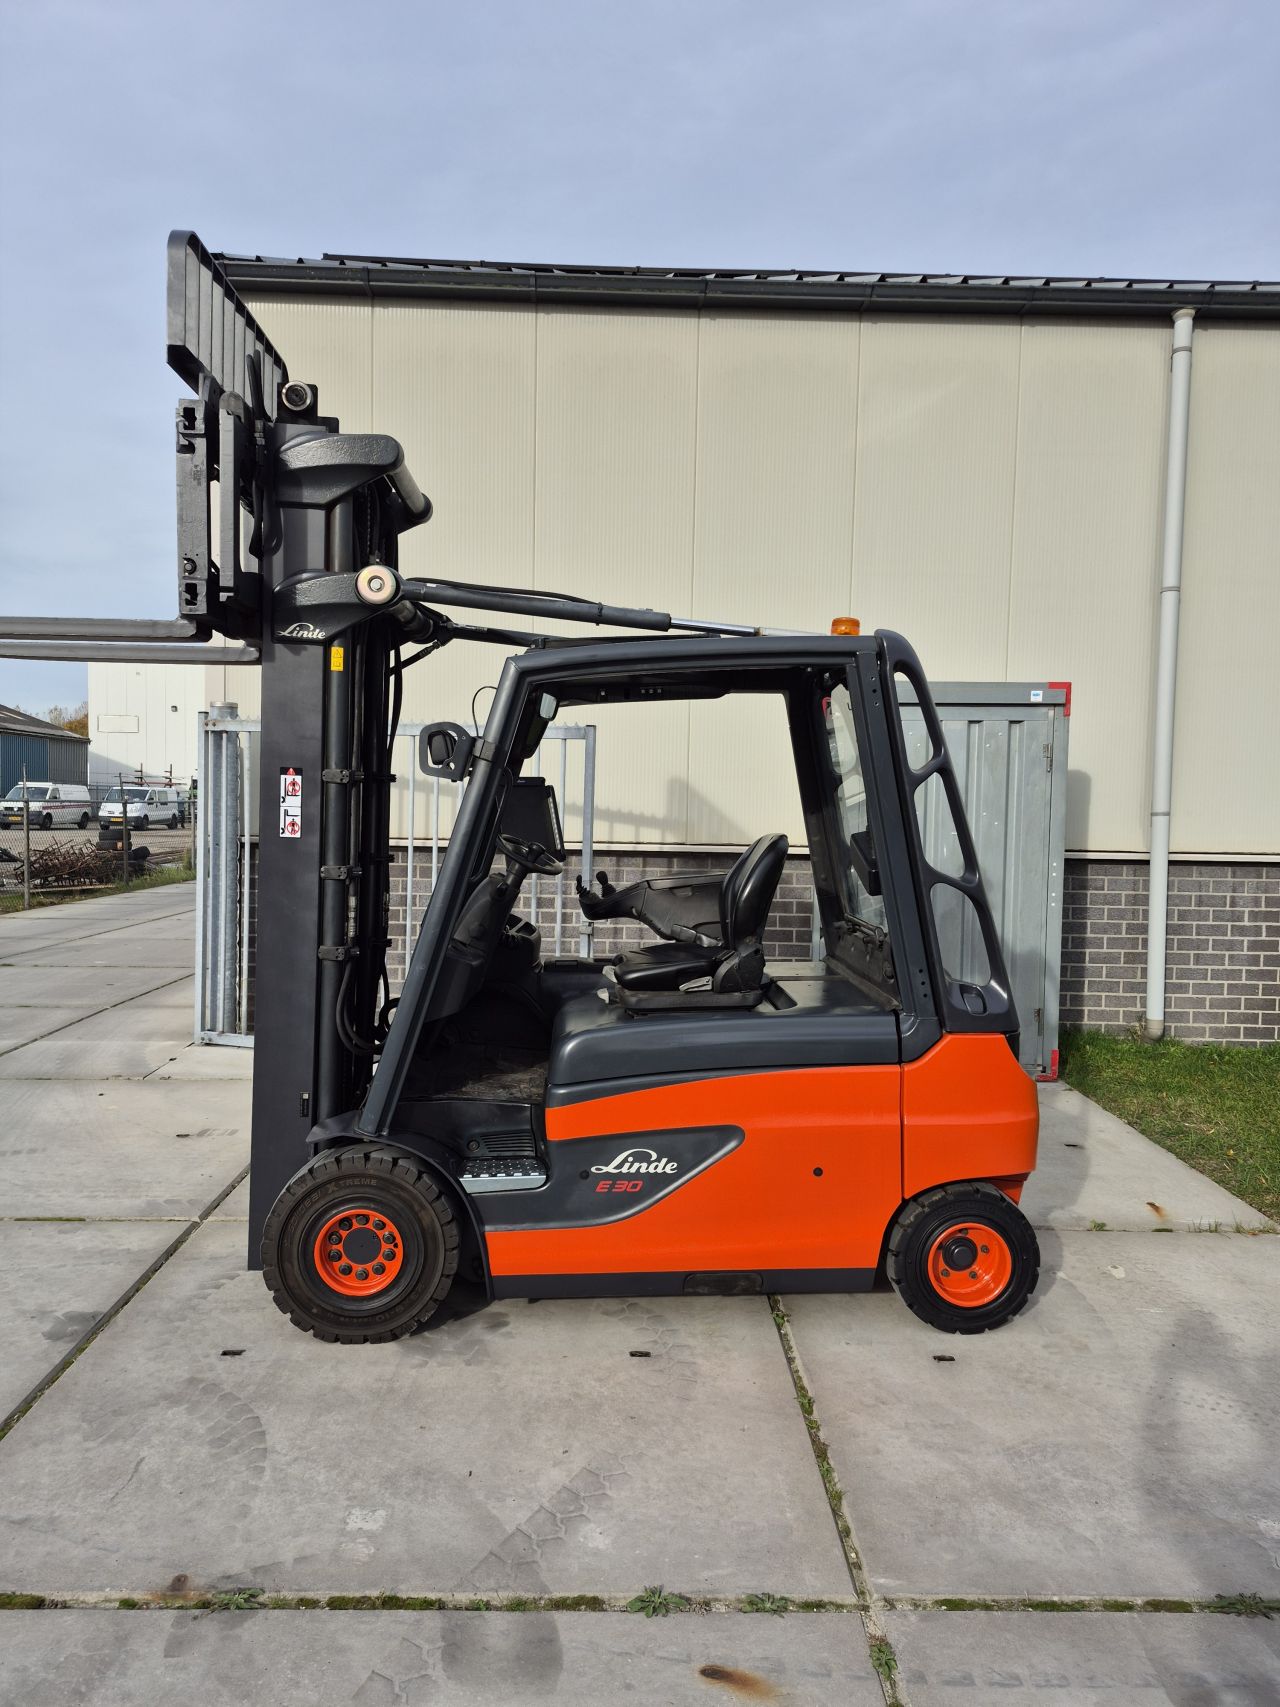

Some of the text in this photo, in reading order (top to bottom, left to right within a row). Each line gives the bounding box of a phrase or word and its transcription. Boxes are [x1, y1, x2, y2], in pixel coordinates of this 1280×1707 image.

[277, 622, 326, 639] Linde
[591, 1149, 678, 1174] Linde
[596, 1181, 643, 1193] E 30
